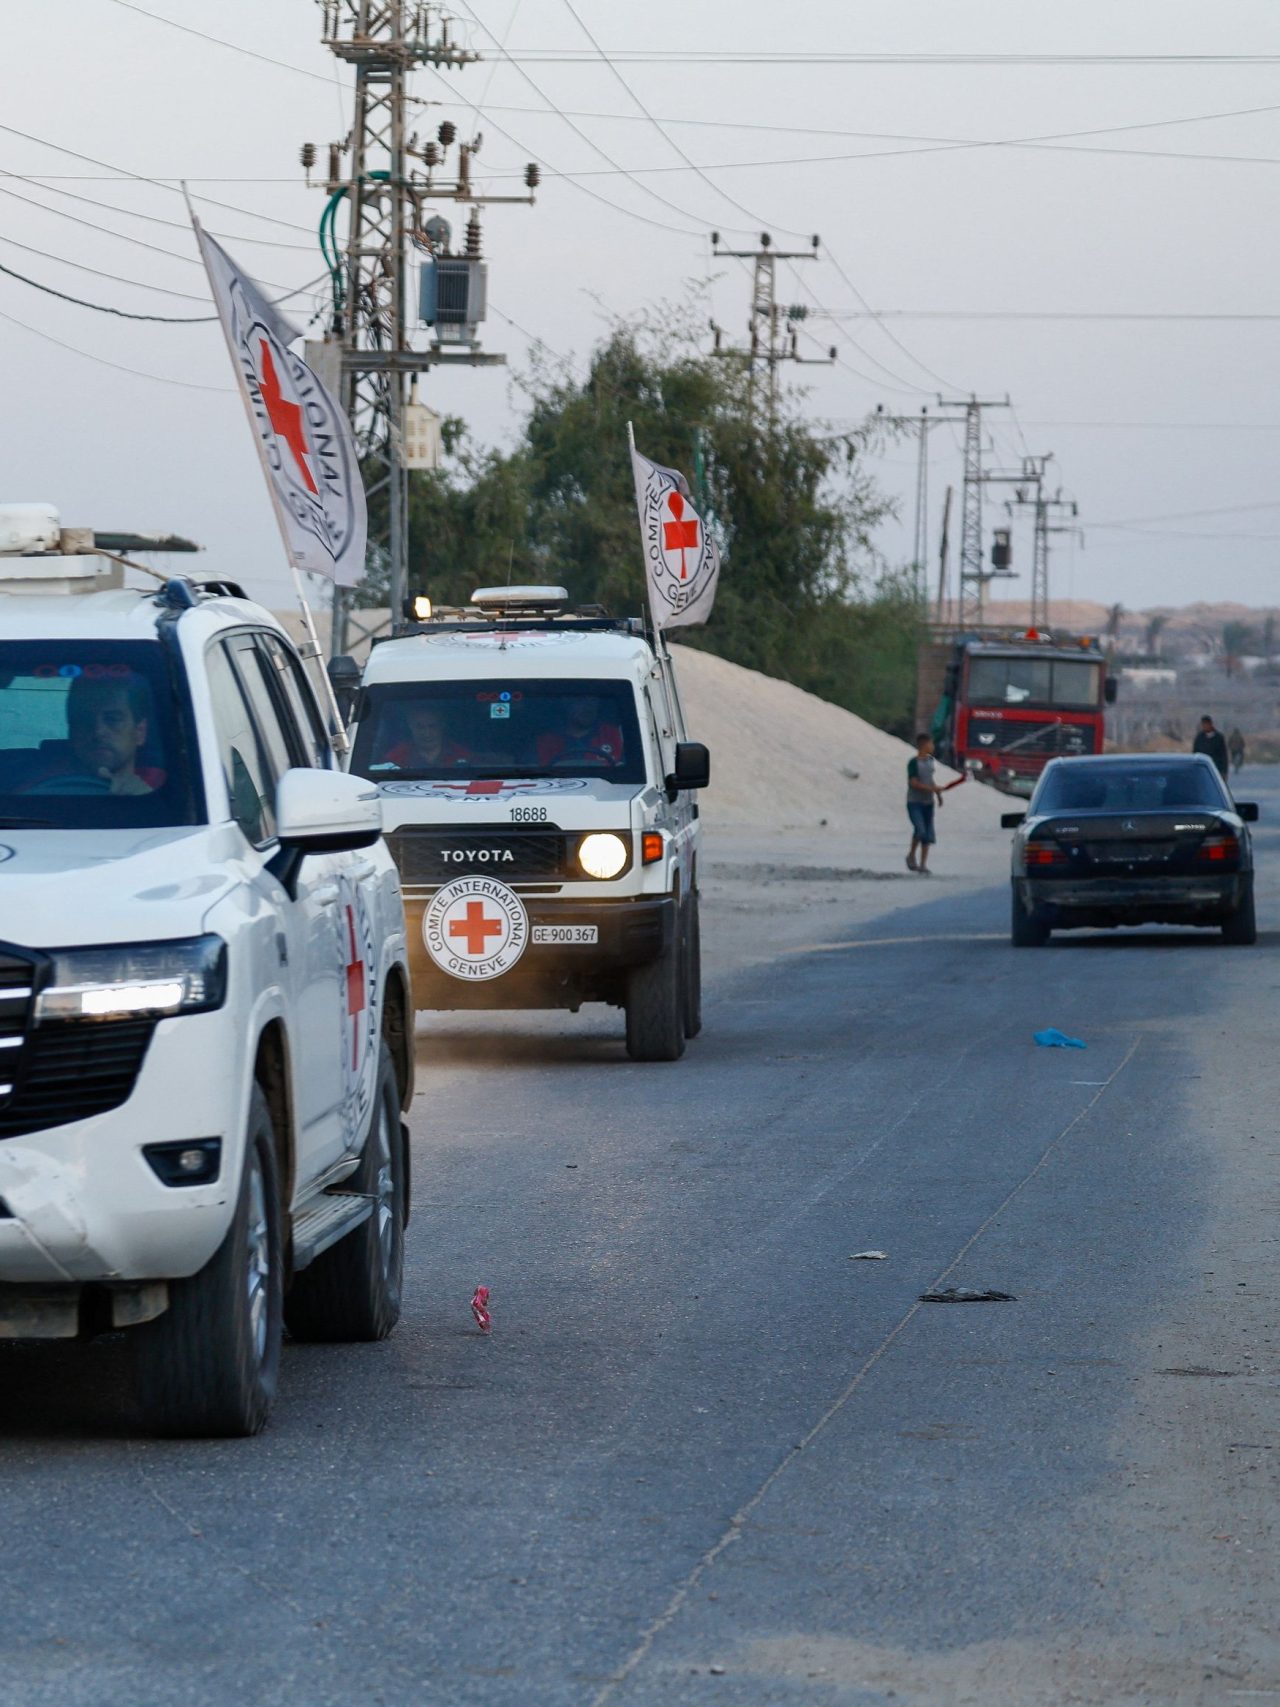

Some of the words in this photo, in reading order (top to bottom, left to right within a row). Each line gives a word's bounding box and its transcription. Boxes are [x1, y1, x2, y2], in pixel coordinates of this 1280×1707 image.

[509, 807, 548, 822] 18688
[441, 850, 514, 863] TOYOTA
[428, 896, 449, 952] COMITE
[449, 880, 523, 950] INTERNATIONAL
[448, 955, 507, 976] GENEVE
